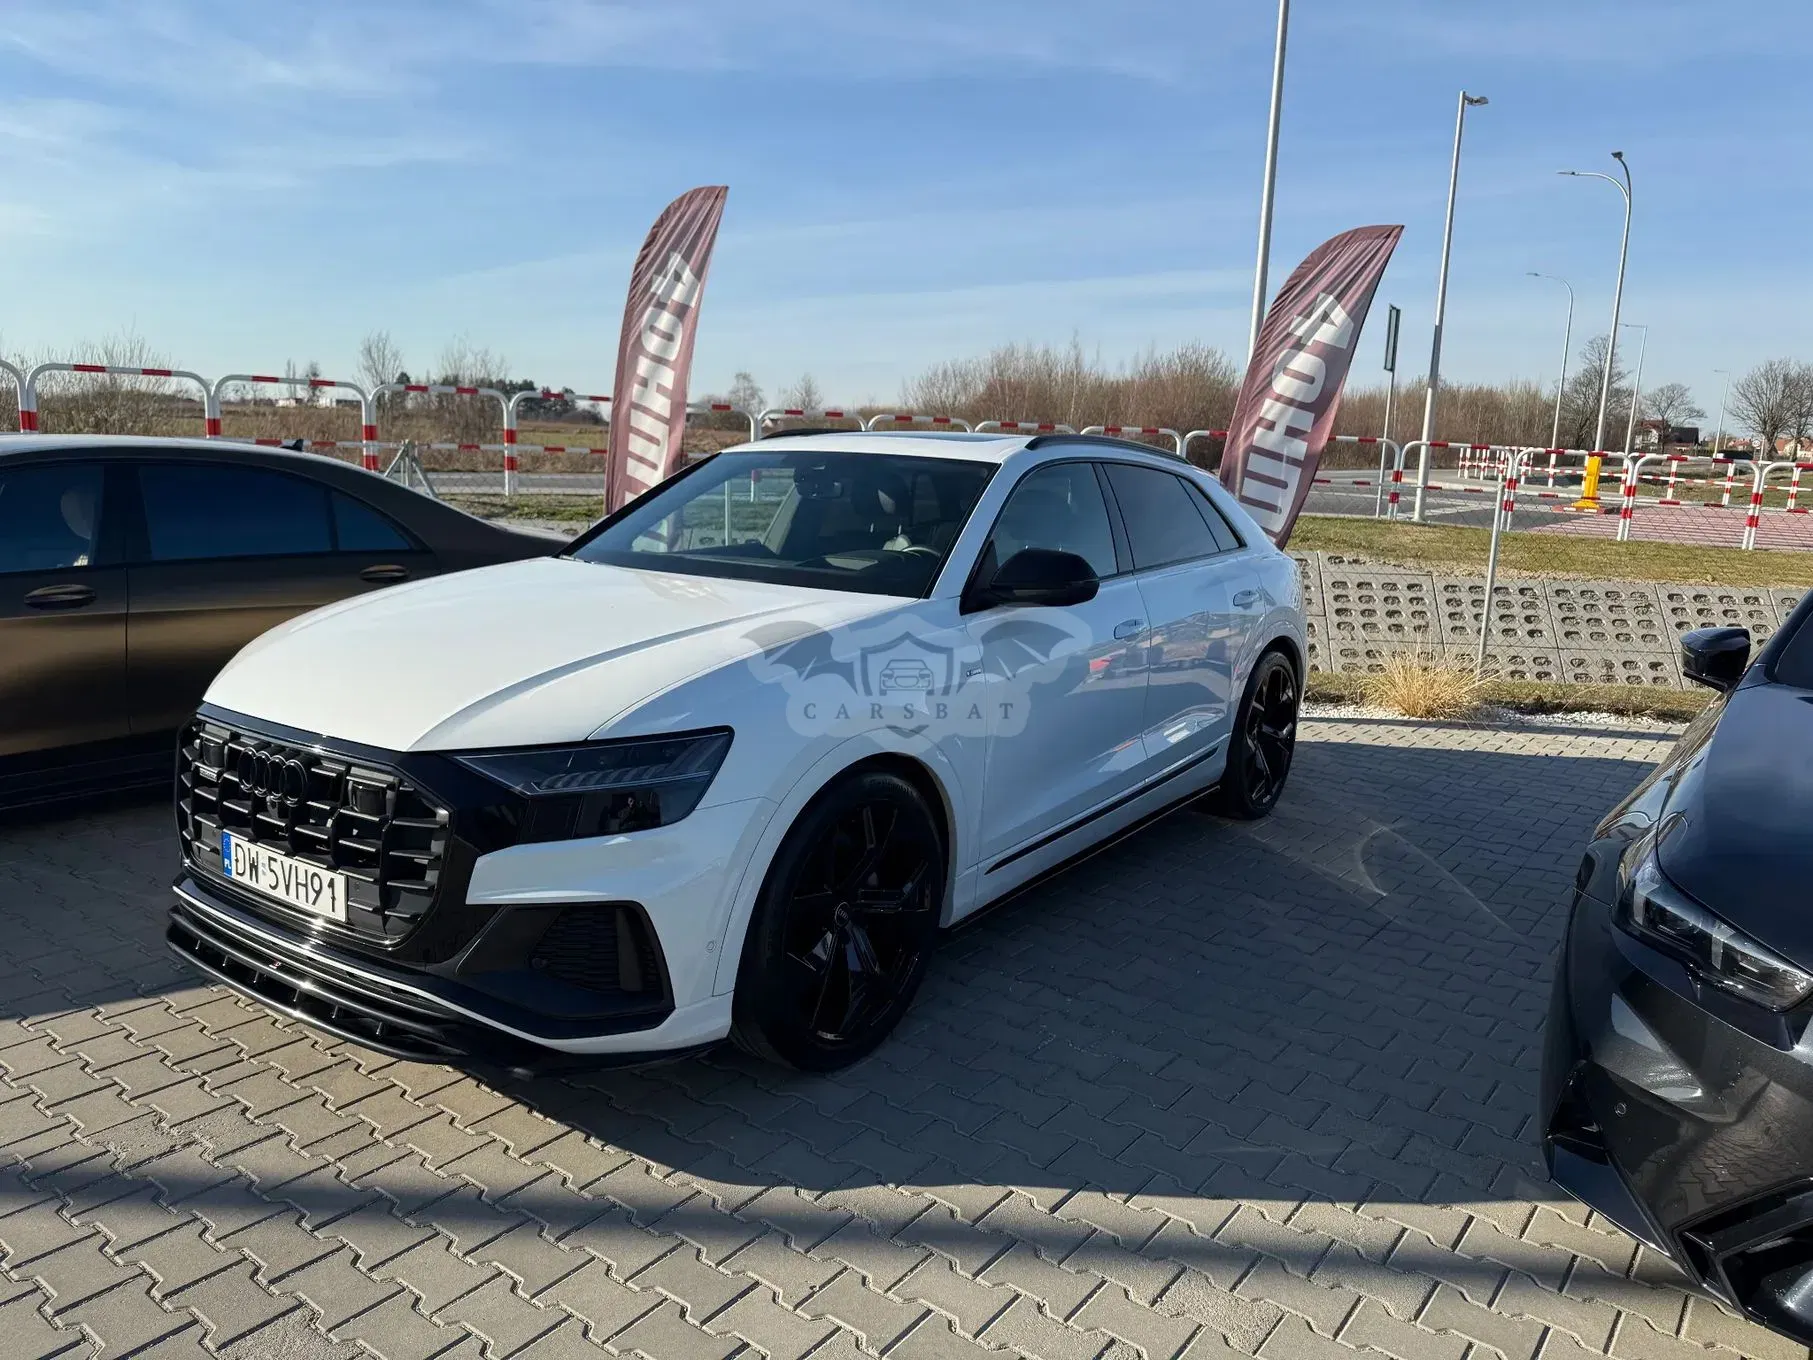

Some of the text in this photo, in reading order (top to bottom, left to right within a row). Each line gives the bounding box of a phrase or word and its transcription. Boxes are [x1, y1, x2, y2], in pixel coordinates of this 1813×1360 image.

[224, 858, 232, 870] PL
[234, 842, 337, 912] DW 5VH91
